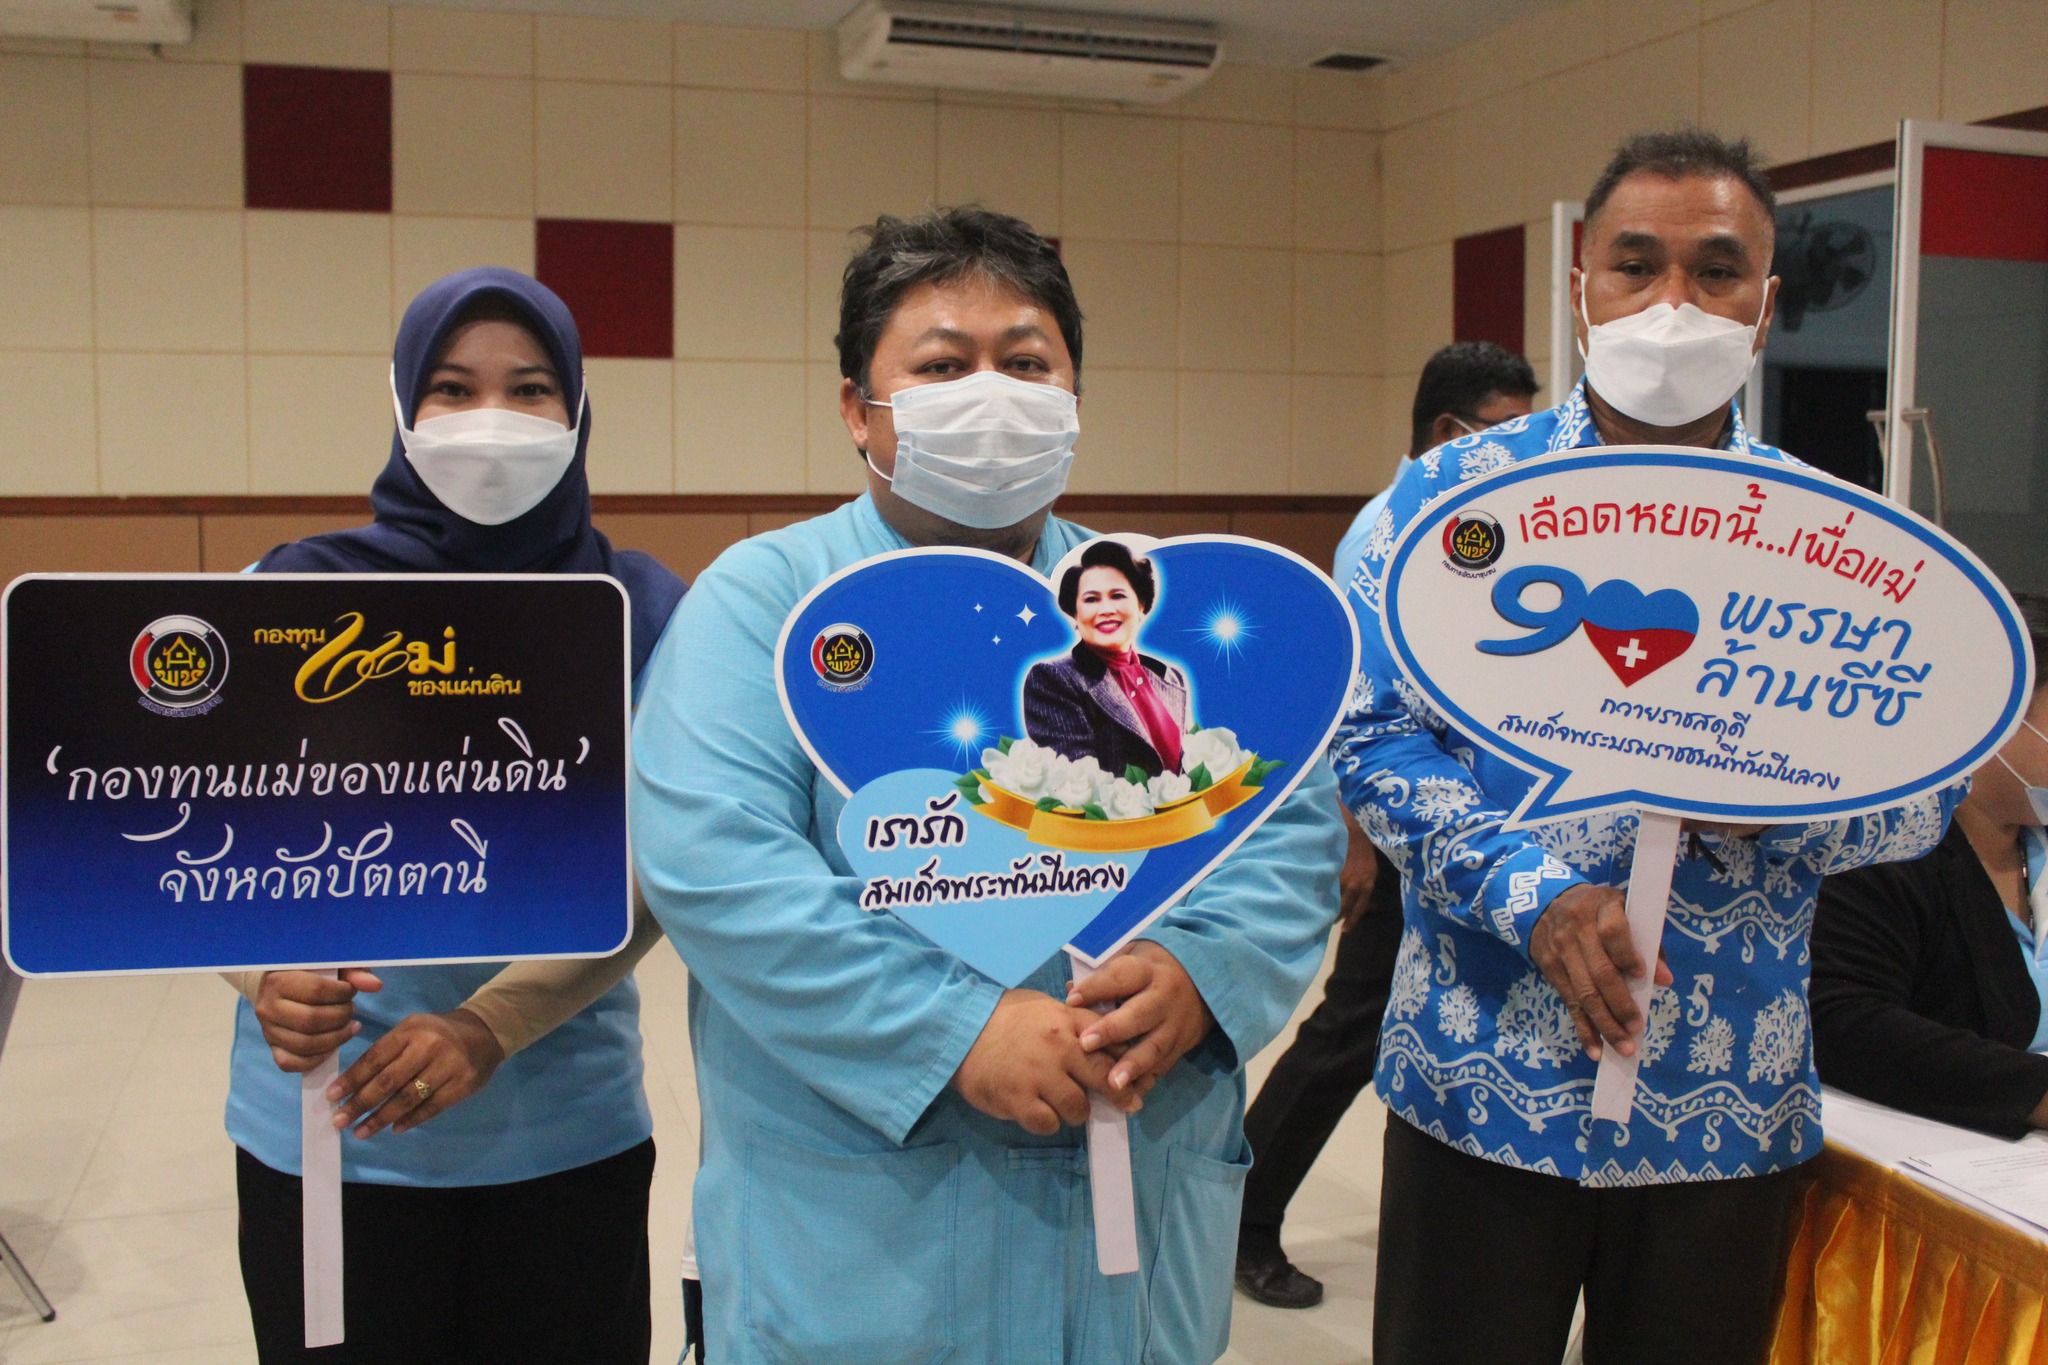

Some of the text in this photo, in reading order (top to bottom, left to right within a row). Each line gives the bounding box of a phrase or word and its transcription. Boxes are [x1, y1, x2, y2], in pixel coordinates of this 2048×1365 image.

[254, 628, 325, 651] กองทุน
[1719, 592, 1913, 661] พรรษา
[407, 666, 522, 696] ของแผ่นดิน
[1696, 638, 1933, 728] ล้านซีซี
[1599, 698, 1752, 744] ถวายราชสดุดี
[1497, 711, 1841, 791] สมเด็จพระบรมราชชนนีพันปีหลวง
[868, 793, 964, 849] เรารัก
[159, 818, 489, 903] จังหวัดปัตตานี
[864, 854, 1125, 908] สมเด็จพระพันปีหลวง
